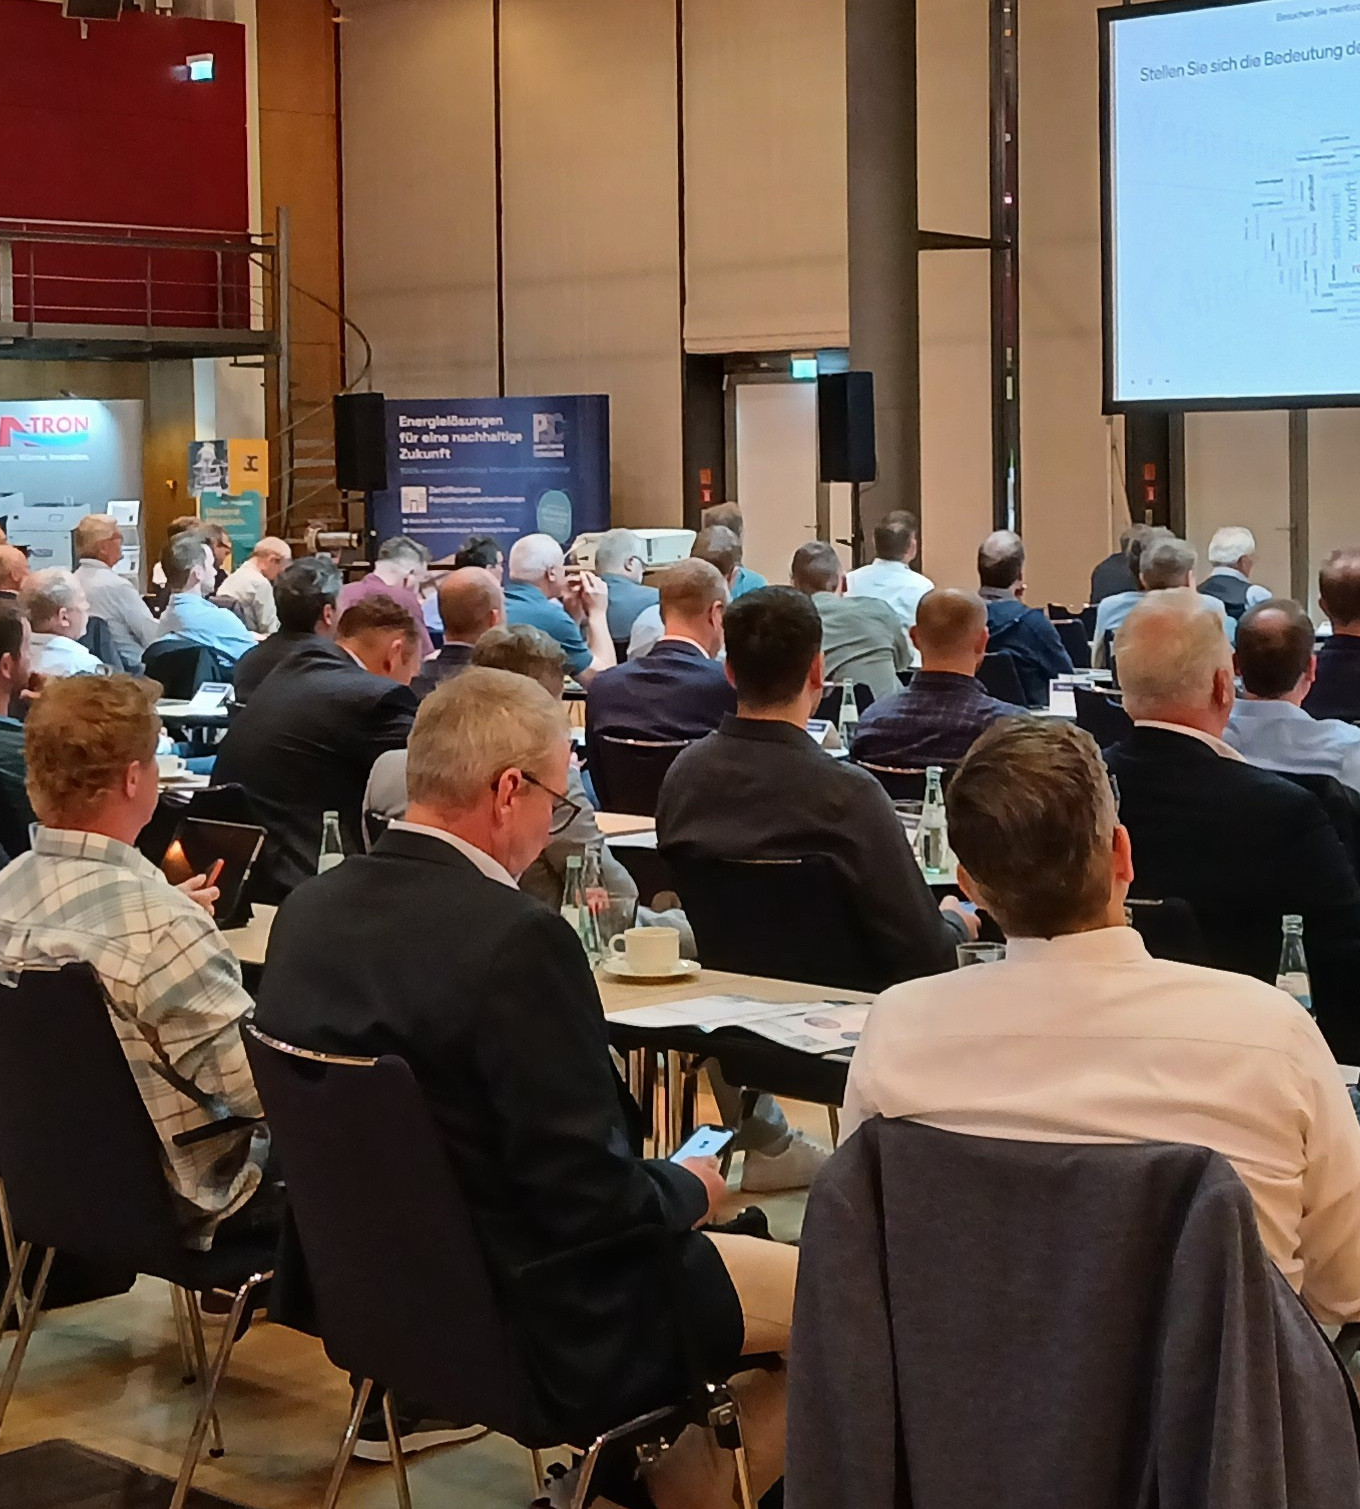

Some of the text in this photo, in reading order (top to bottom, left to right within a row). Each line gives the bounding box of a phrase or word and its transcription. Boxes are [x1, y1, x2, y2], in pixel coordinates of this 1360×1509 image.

[1140, 64, 1185, 82] Stellen
[1187, 60, 1208, 77] Sie
[1211, 57, 1238, 73] sich
[1240, 53, 1262, 69] die
[1264, 44, 1343, 67] Bedeutung
[1344, 181, 1358, 242] zukunft
[398, 415, 504, 430] Energielösungen
[398, 431, 523, 445] für eine nachhaltige
[398, 448, 452, 460] Zukunft
